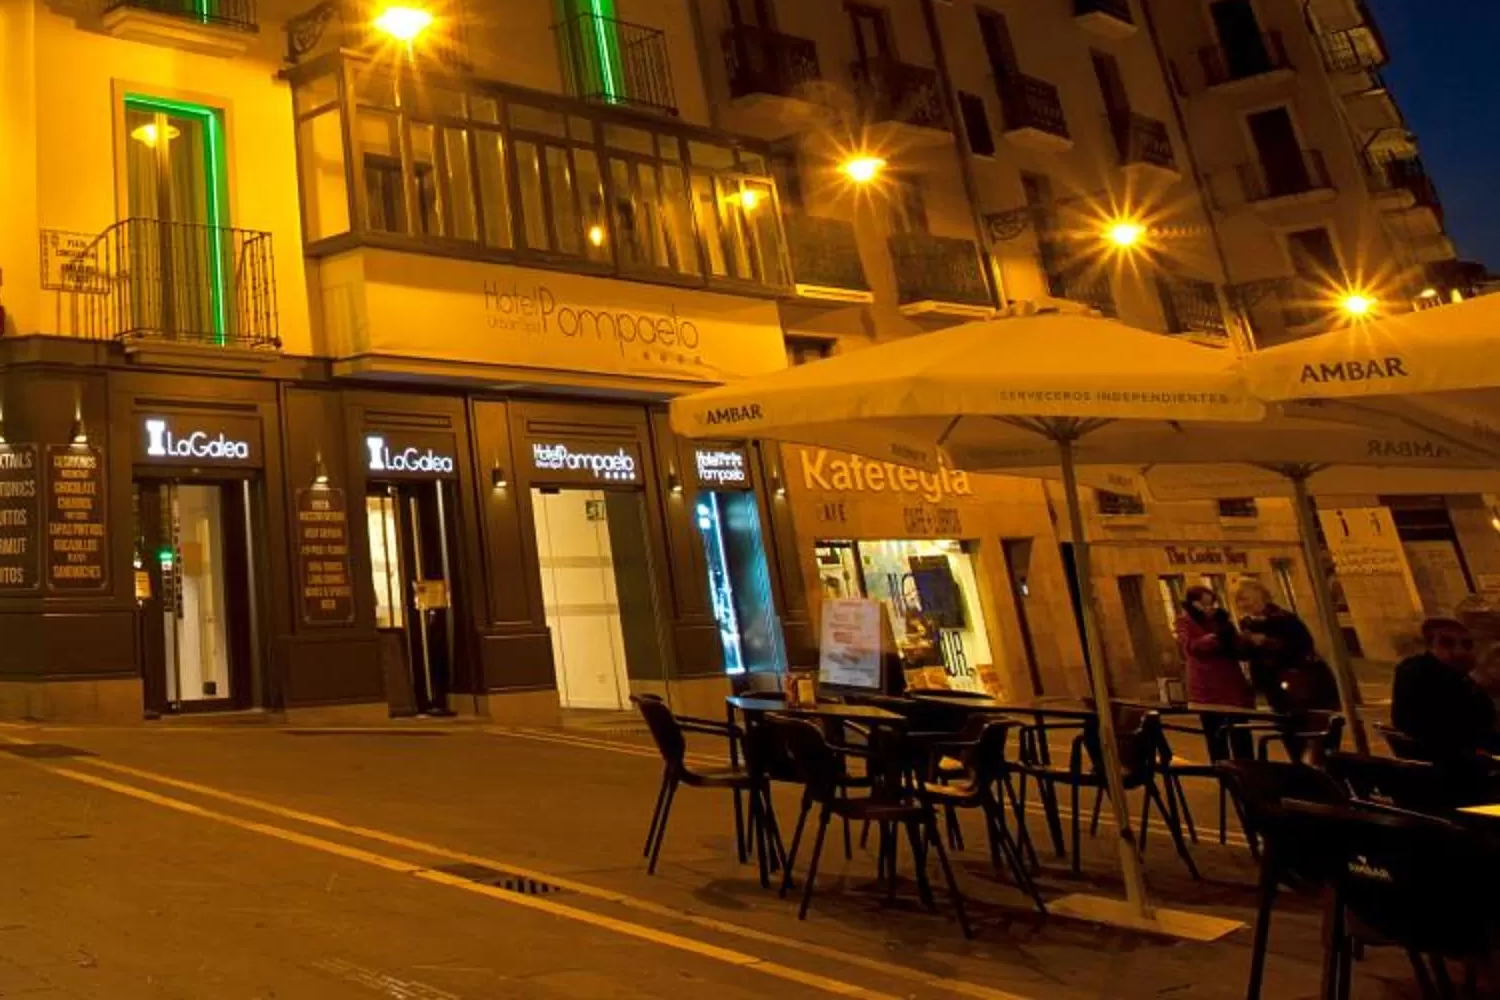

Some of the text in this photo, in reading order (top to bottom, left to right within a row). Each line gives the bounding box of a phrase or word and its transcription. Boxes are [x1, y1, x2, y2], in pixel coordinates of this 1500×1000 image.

[483, 280, 699, 358] Hotel Pompaelo
[1301, 357, 1409, 383] AMBAR
[706, 403, 764, 425] AMBAR
